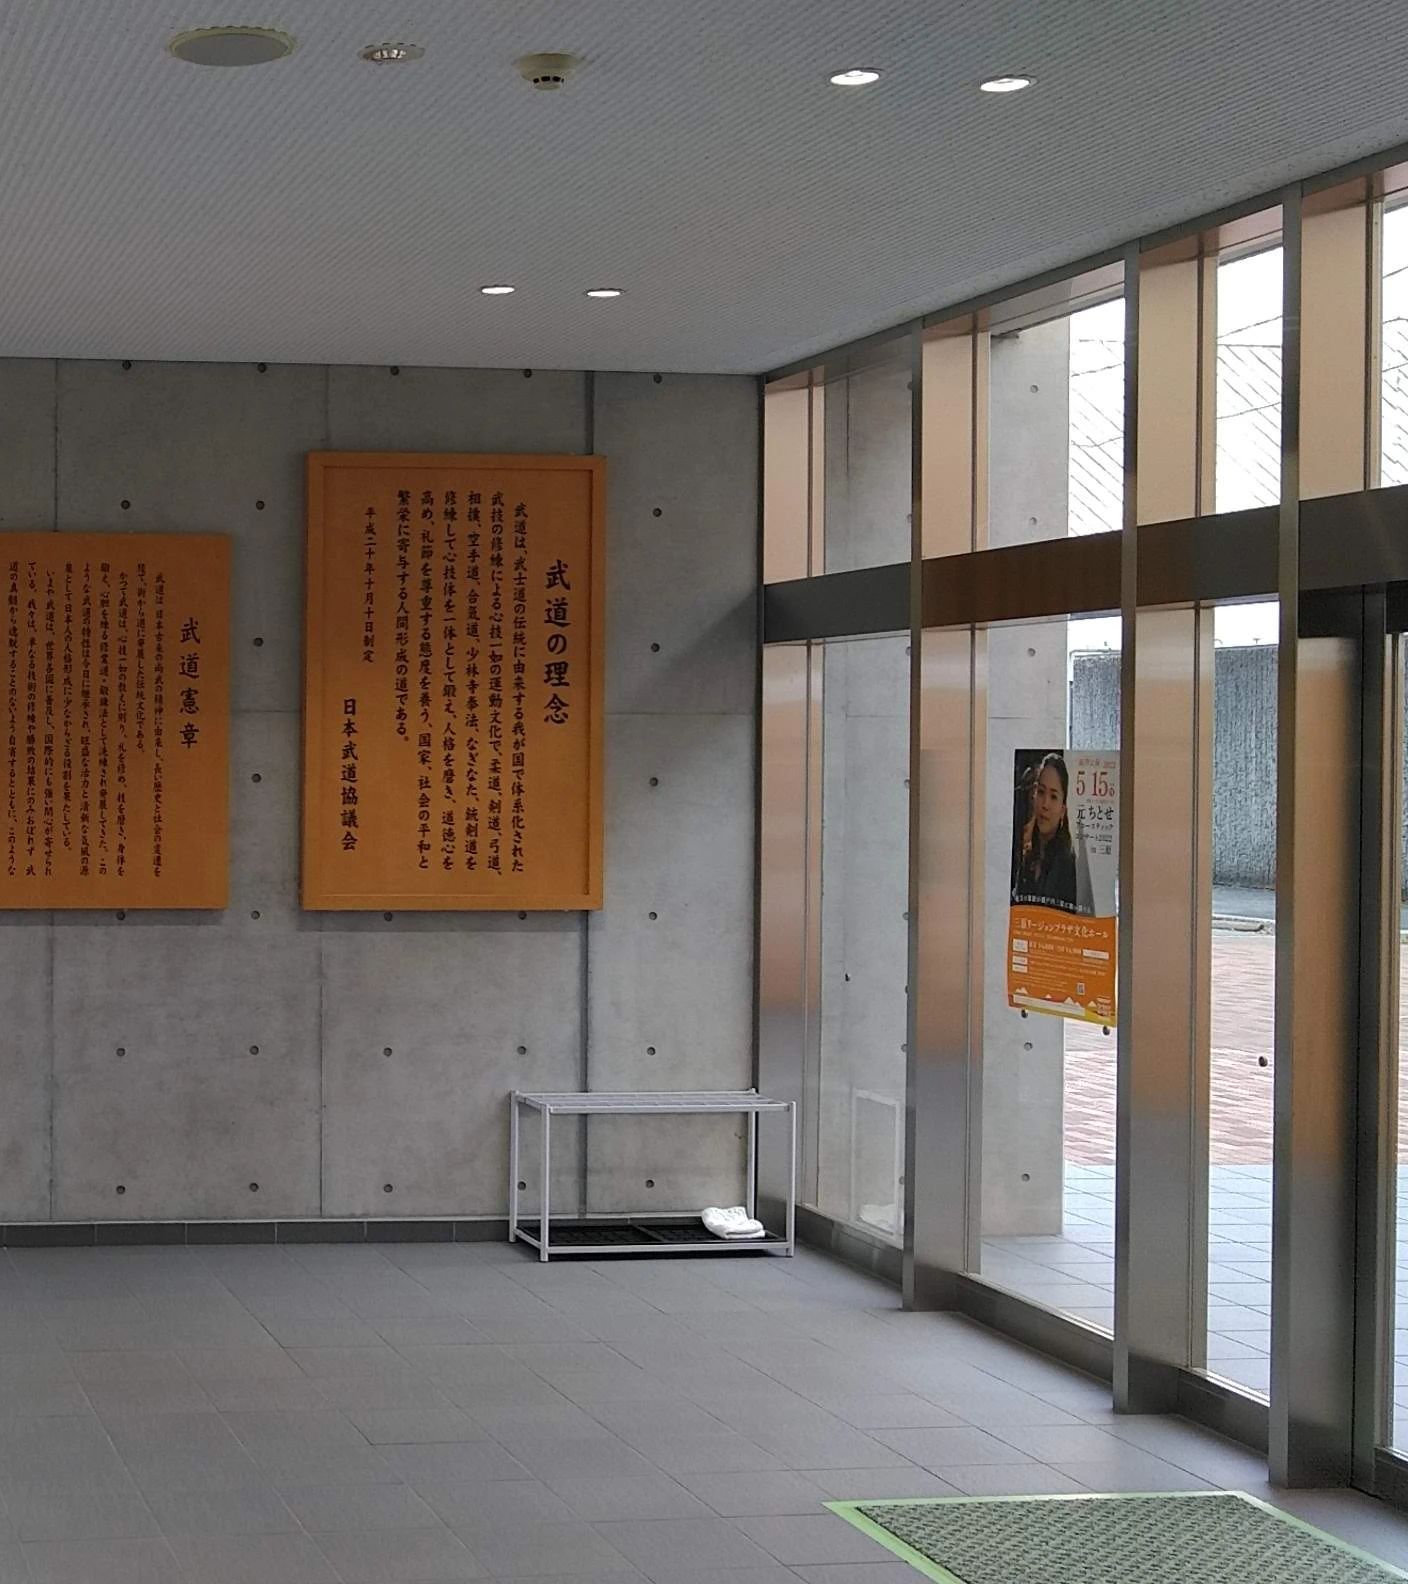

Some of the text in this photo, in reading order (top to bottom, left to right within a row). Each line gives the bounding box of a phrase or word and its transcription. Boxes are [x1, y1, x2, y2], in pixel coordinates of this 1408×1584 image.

[180, 618, 200, 748] 武道憲章
[544, 560, 570, 724] 武道の理念
[341, 699, 358, 850] 日本武道協議会
[1076, 771, 1086, 797] 5
[1092, 771, 1108, 797] 15
[1076, 804, 1114, 821] 元ちとせ
